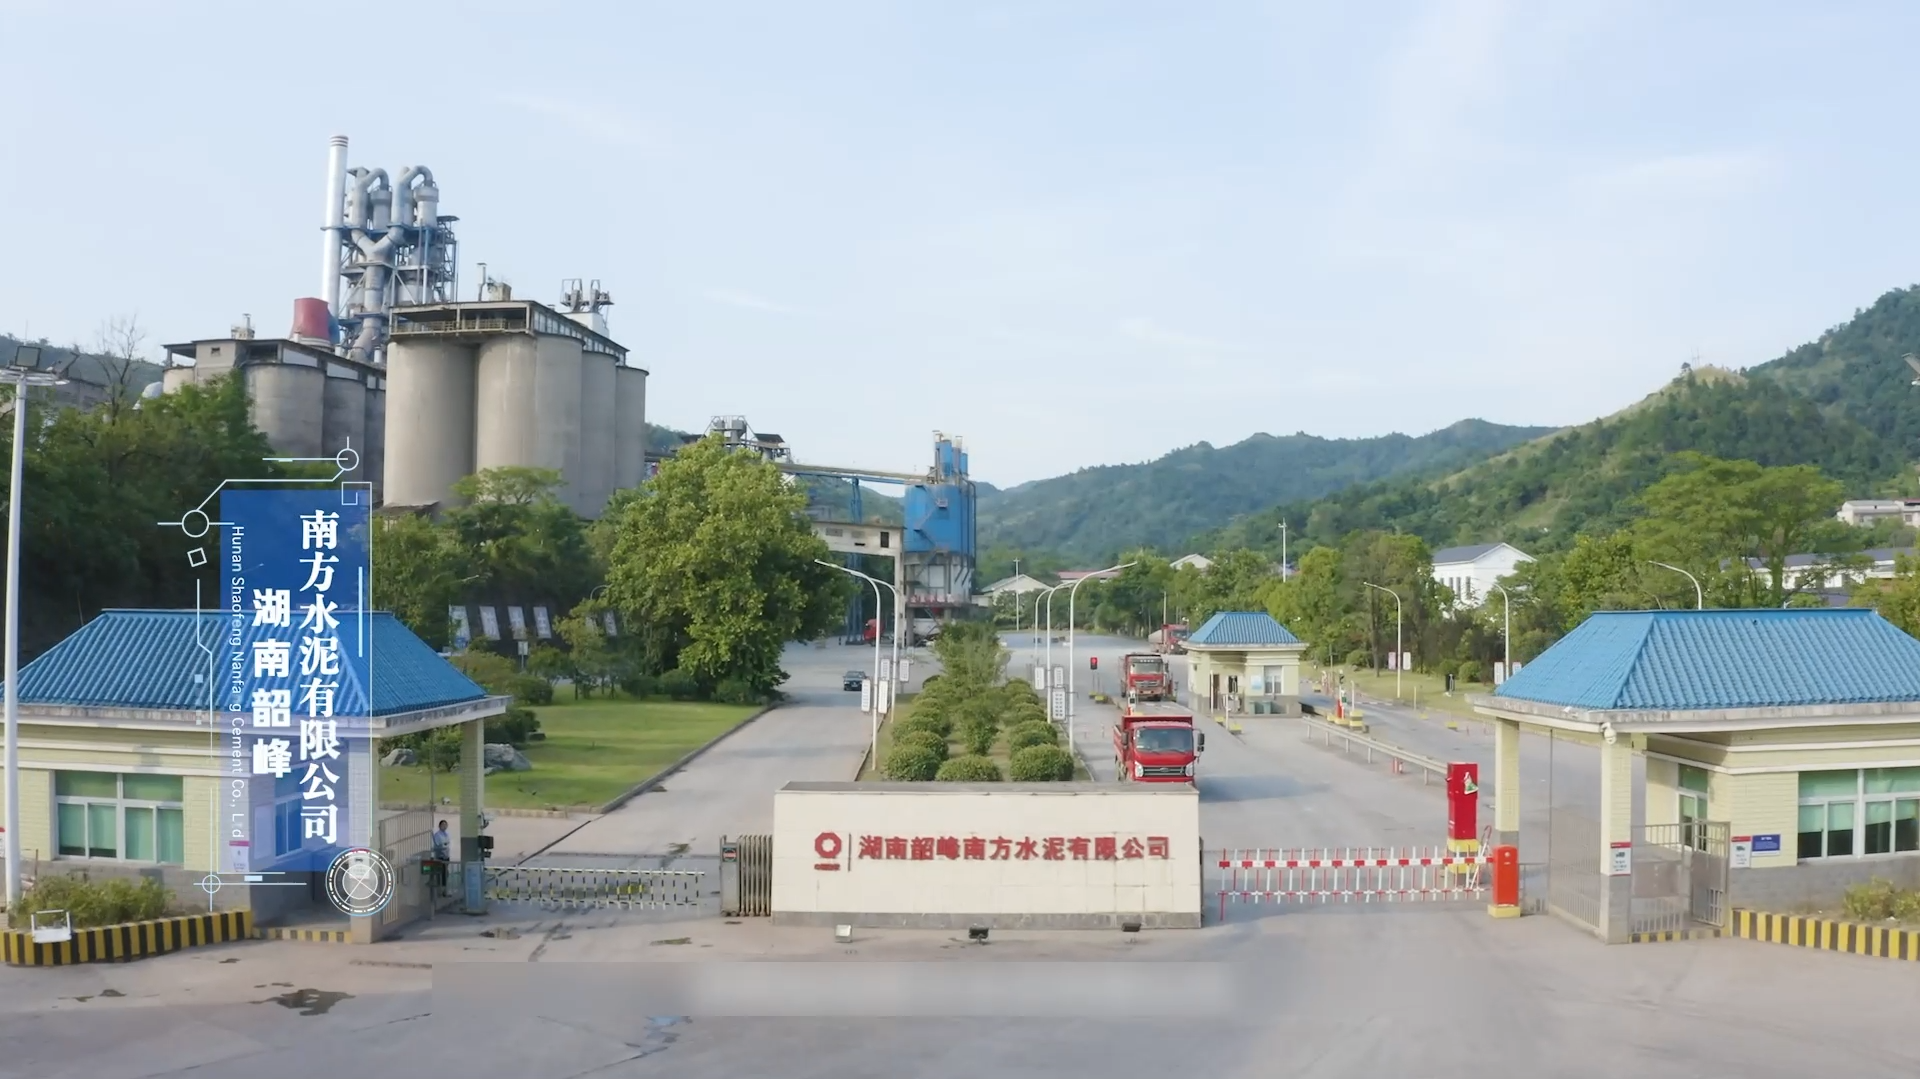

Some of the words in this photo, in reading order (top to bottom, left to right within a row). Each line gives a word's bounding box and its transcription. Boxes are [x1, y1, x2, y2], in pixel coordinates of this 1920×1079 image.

[858, 835, 1170, 860] 湖南韶峰南方水泥有限公司
